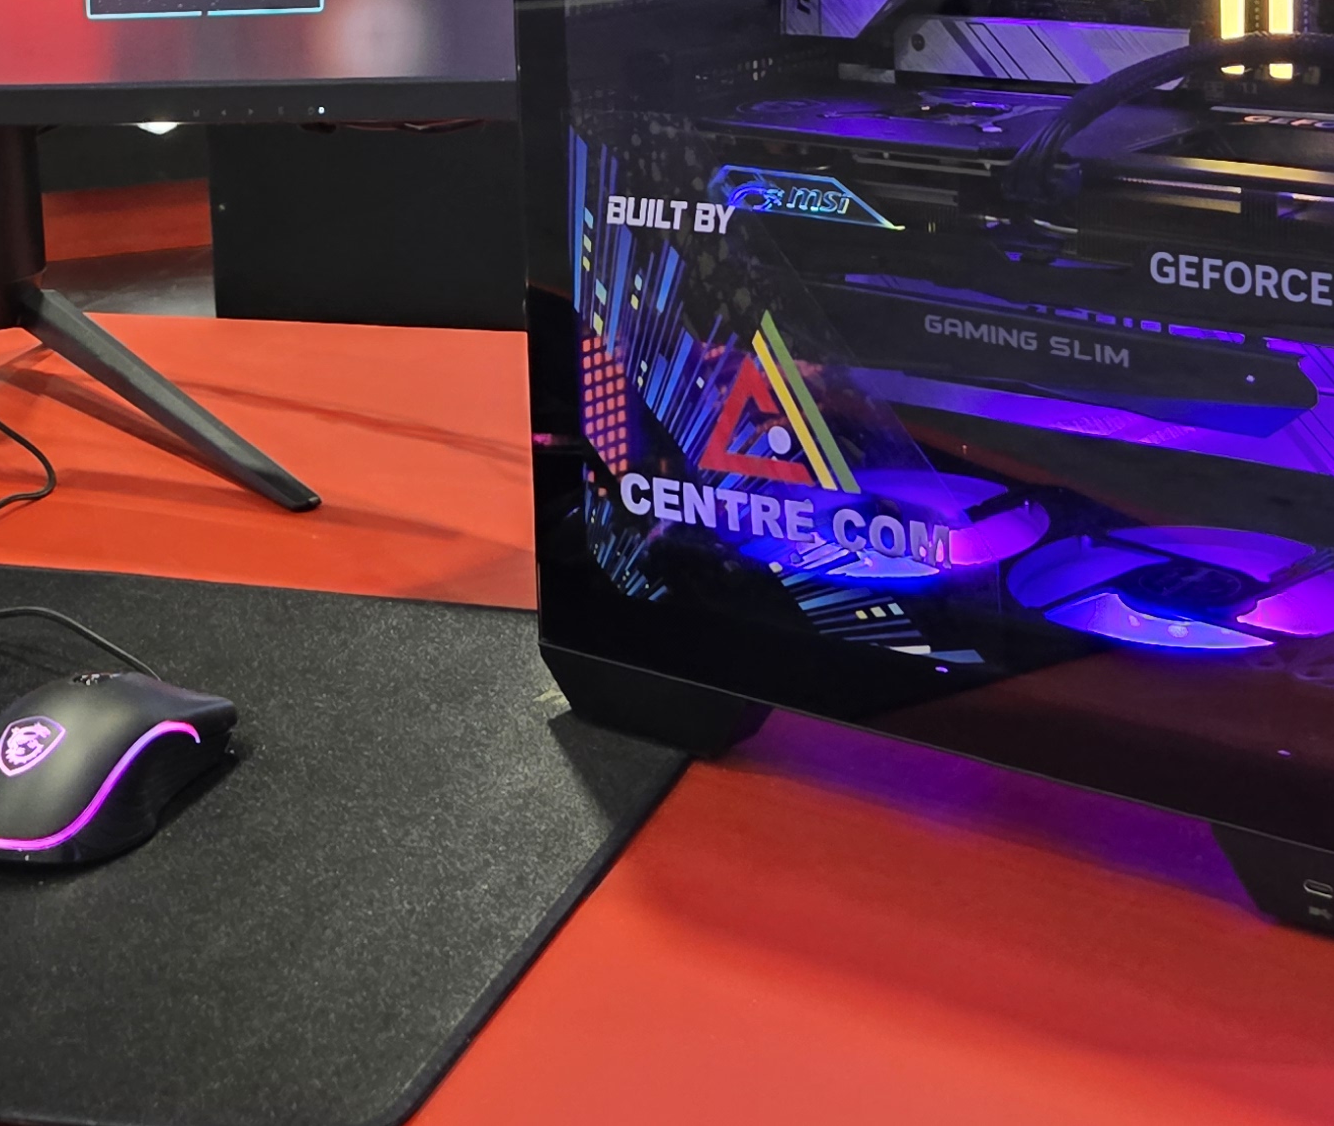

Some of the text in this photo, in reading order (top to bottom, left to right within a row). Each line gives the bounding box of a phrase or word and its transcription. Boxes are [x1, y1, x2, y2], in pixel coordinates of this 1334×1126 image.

[606, 196, 735, 234] BUILT BY
[786, 186, 849, 214] msi
[1149, 251, 1333, 307] GEFORCE
[924, 314, 1130, 369] GAMING SLIM
[619, 473, 952, 569] CENTRE COM
